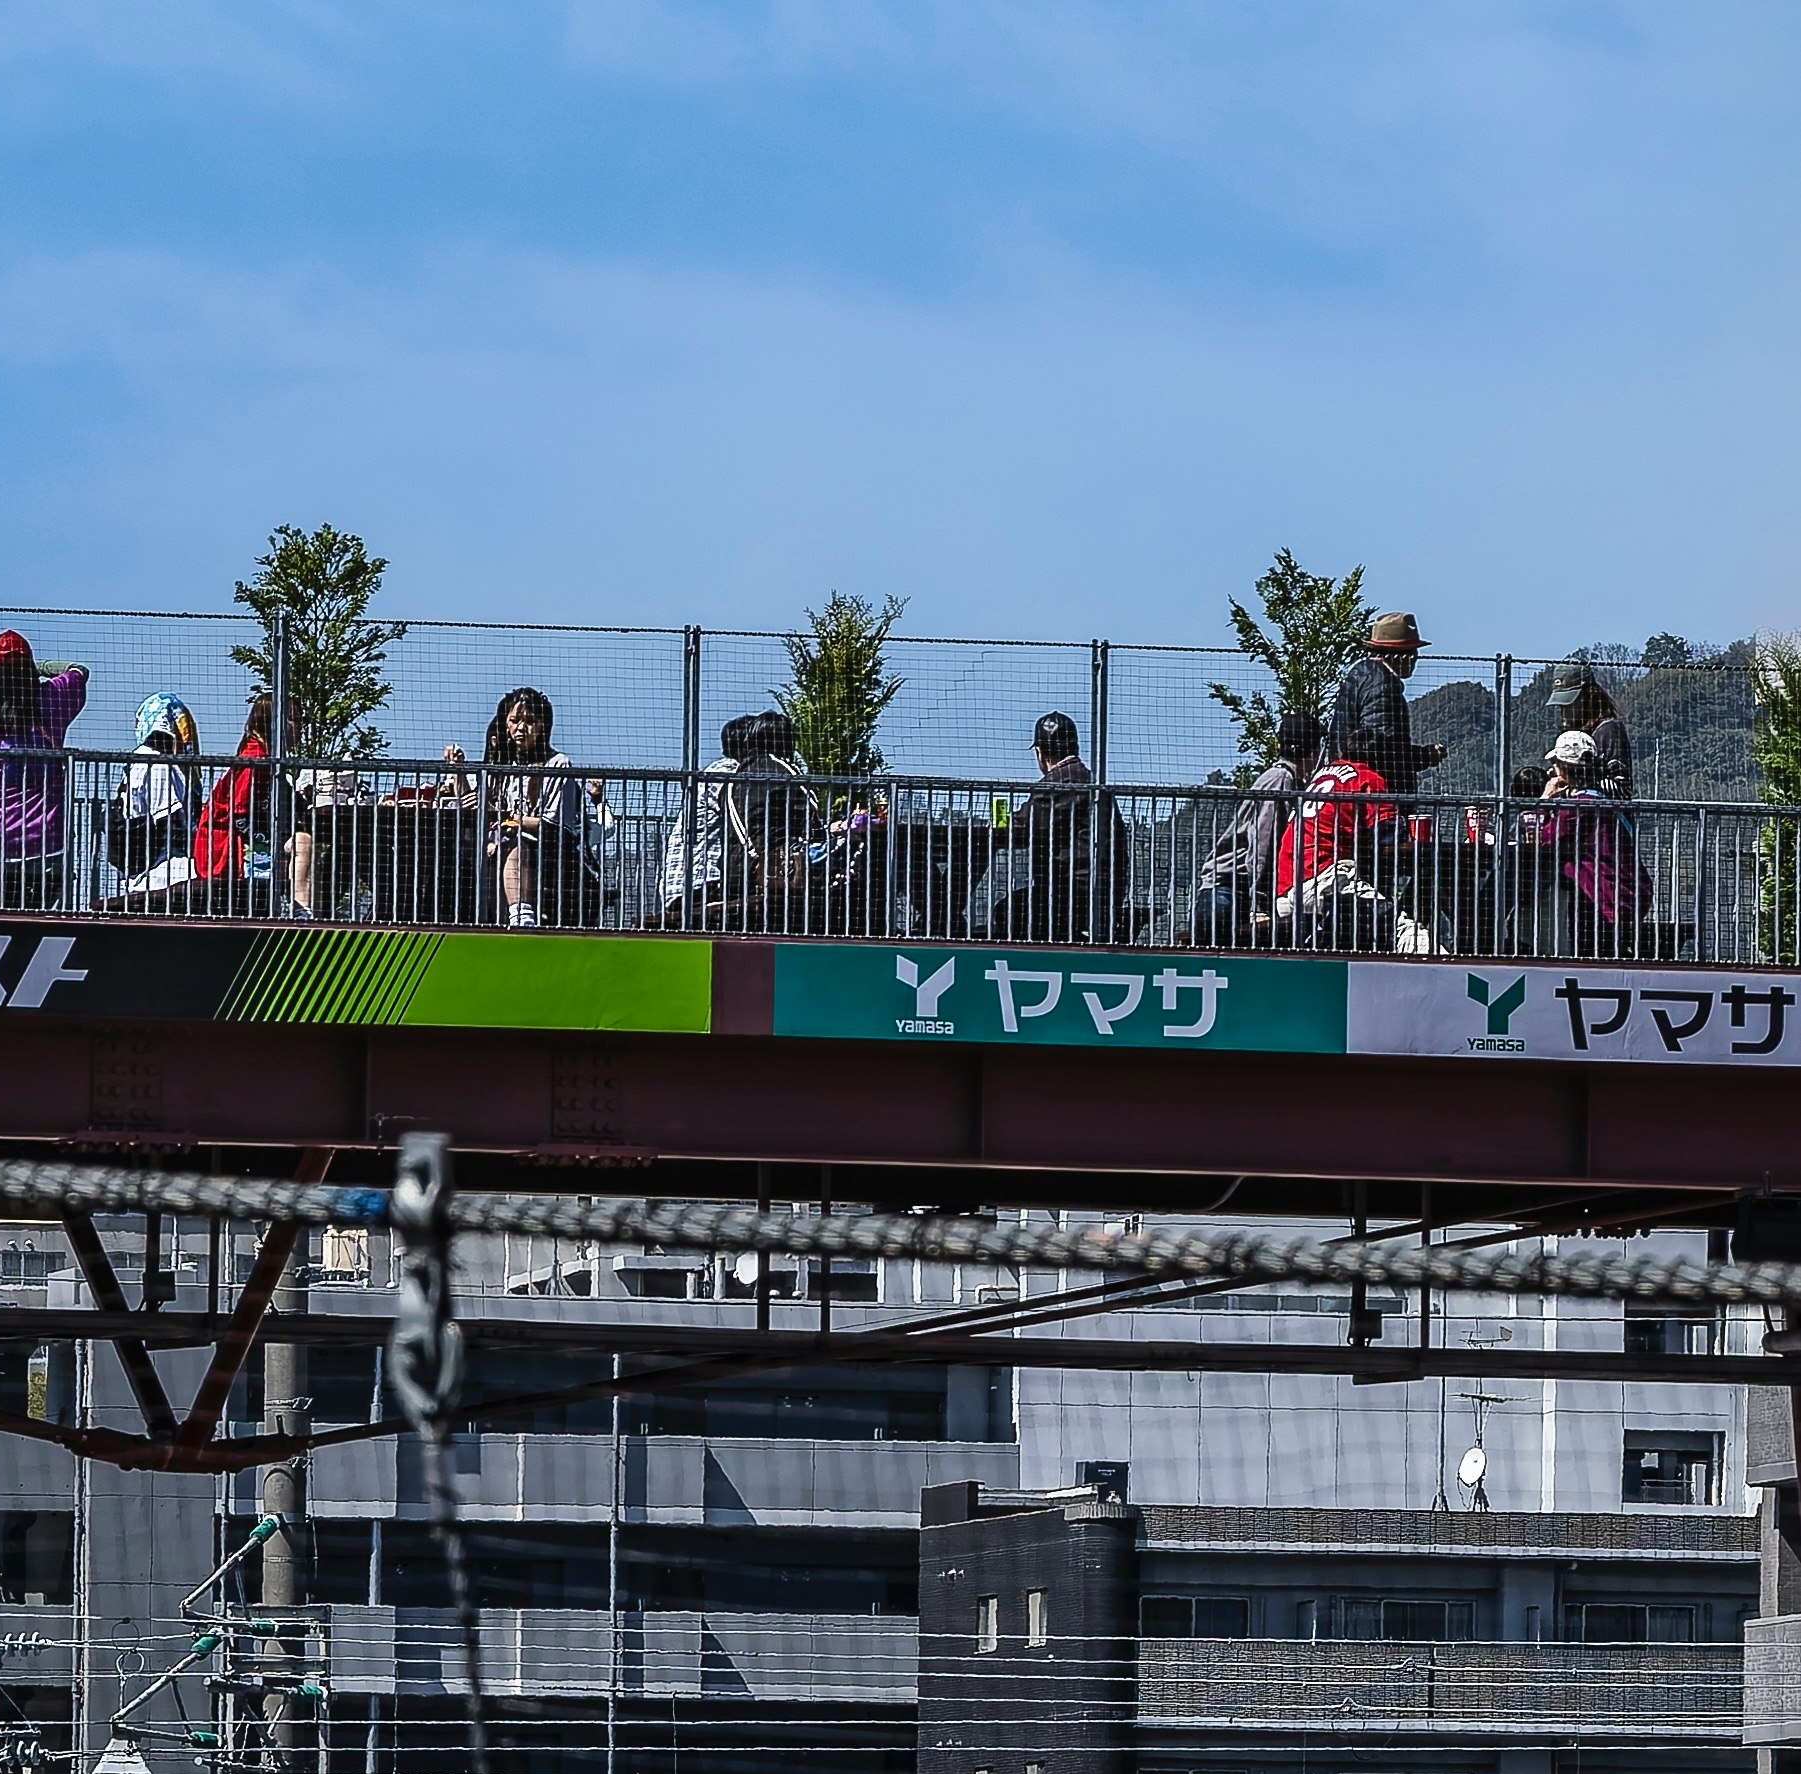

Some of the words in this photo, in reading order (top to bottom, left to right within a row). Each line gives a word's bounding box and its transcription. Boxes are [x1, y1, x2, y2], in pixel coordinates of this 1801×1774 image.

[984, 959, 1229, 1038] ヤマサ
[1554, 977, 1796, 1055] ヤマサ
